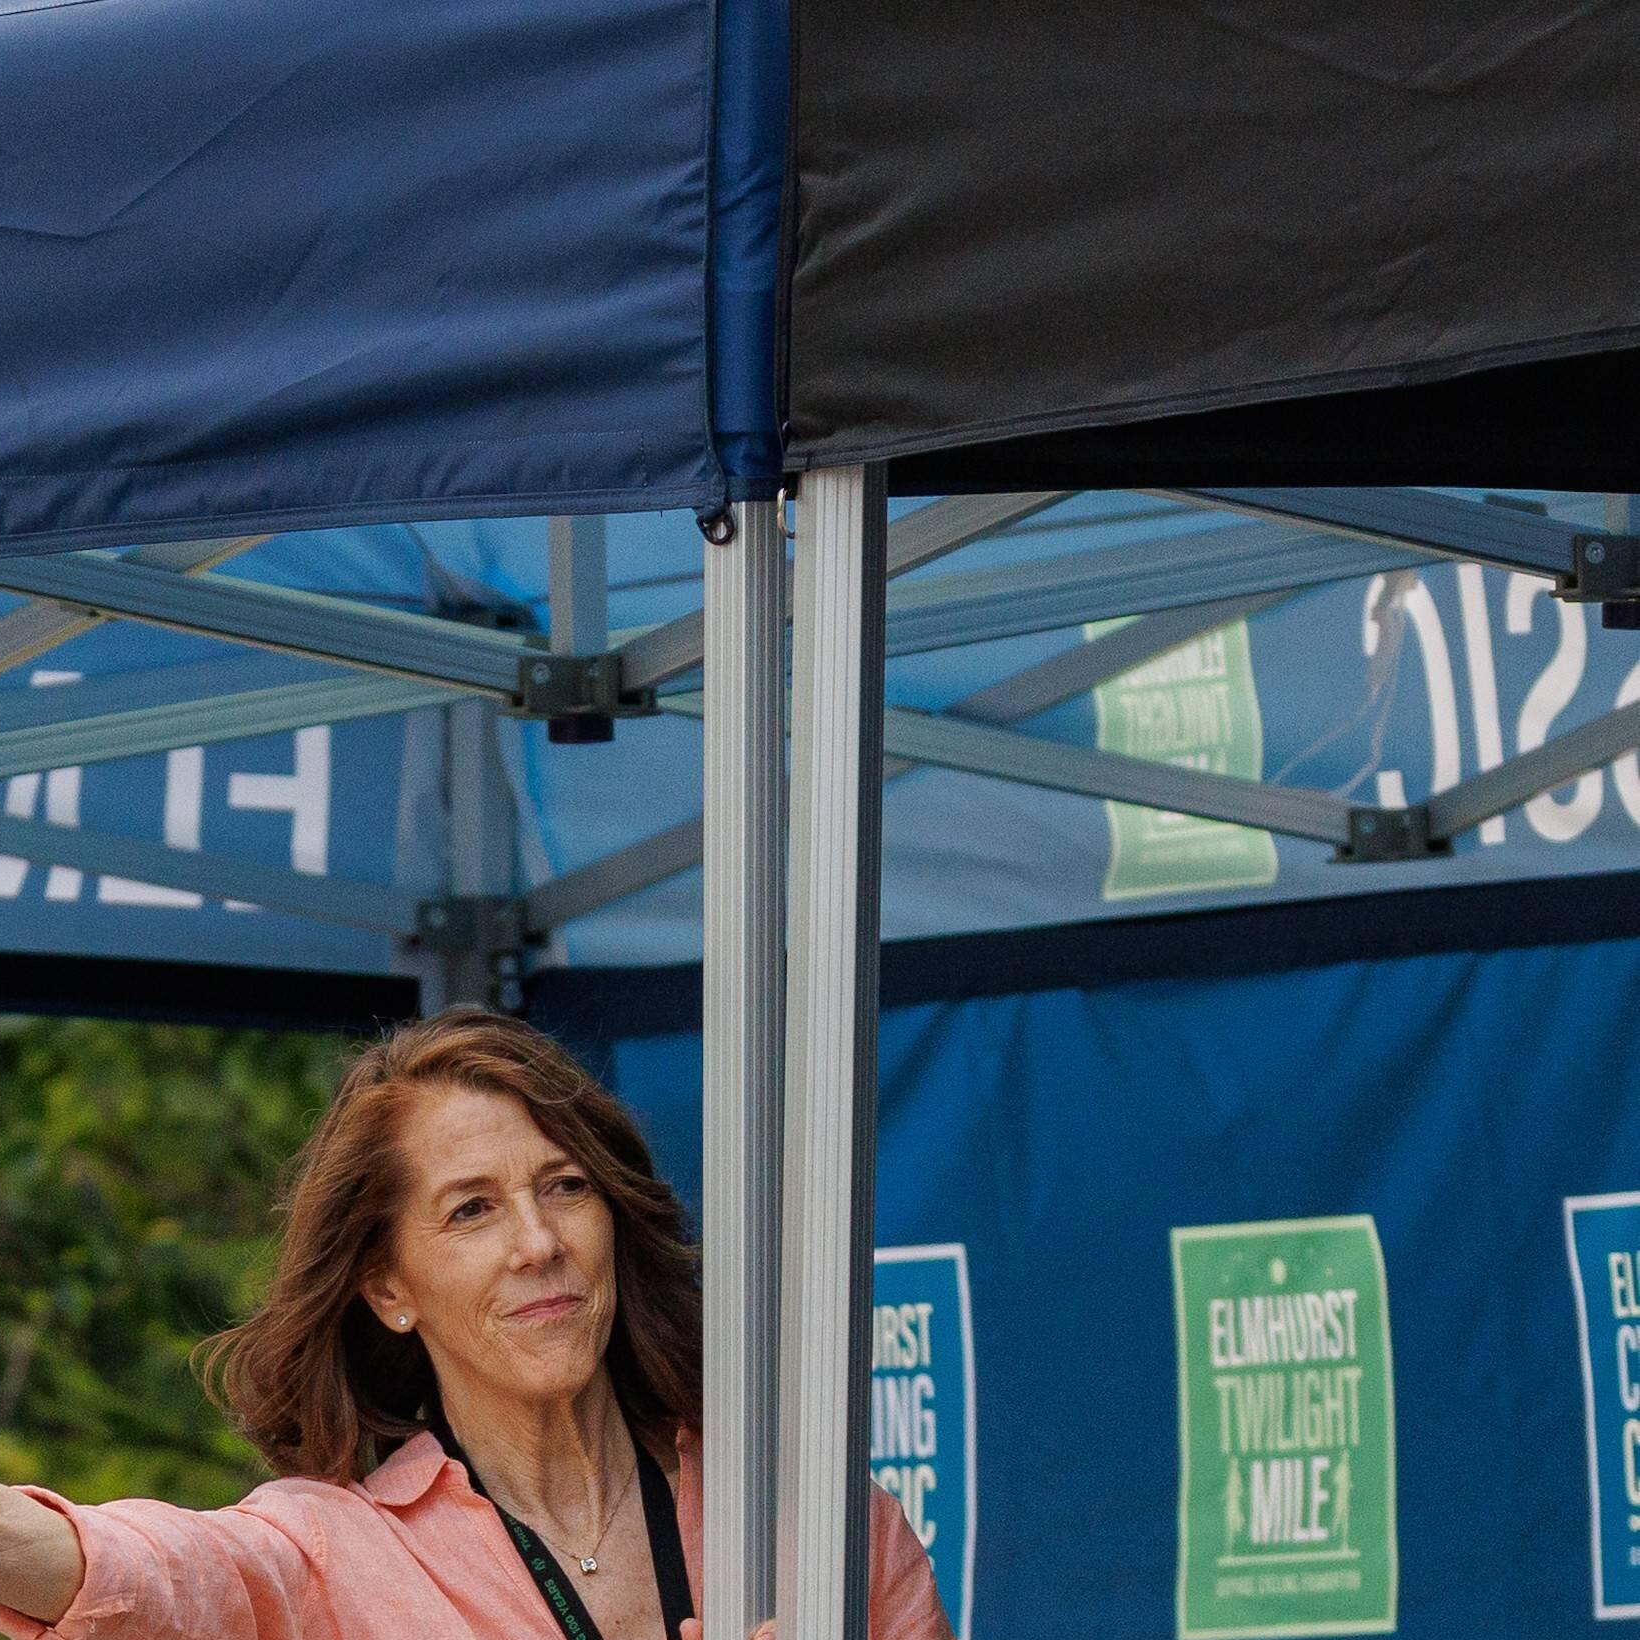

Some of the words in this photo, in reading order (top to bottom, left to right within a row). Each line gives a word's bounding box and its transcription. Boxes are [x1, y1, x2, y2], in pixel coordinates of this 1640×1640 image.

[1209, 1289, 1358, 1368] ELMHURST
[1214, 1366, 1363, 1453] TWILIGHT
[1251, 1455, 1330, 1544] MILE
